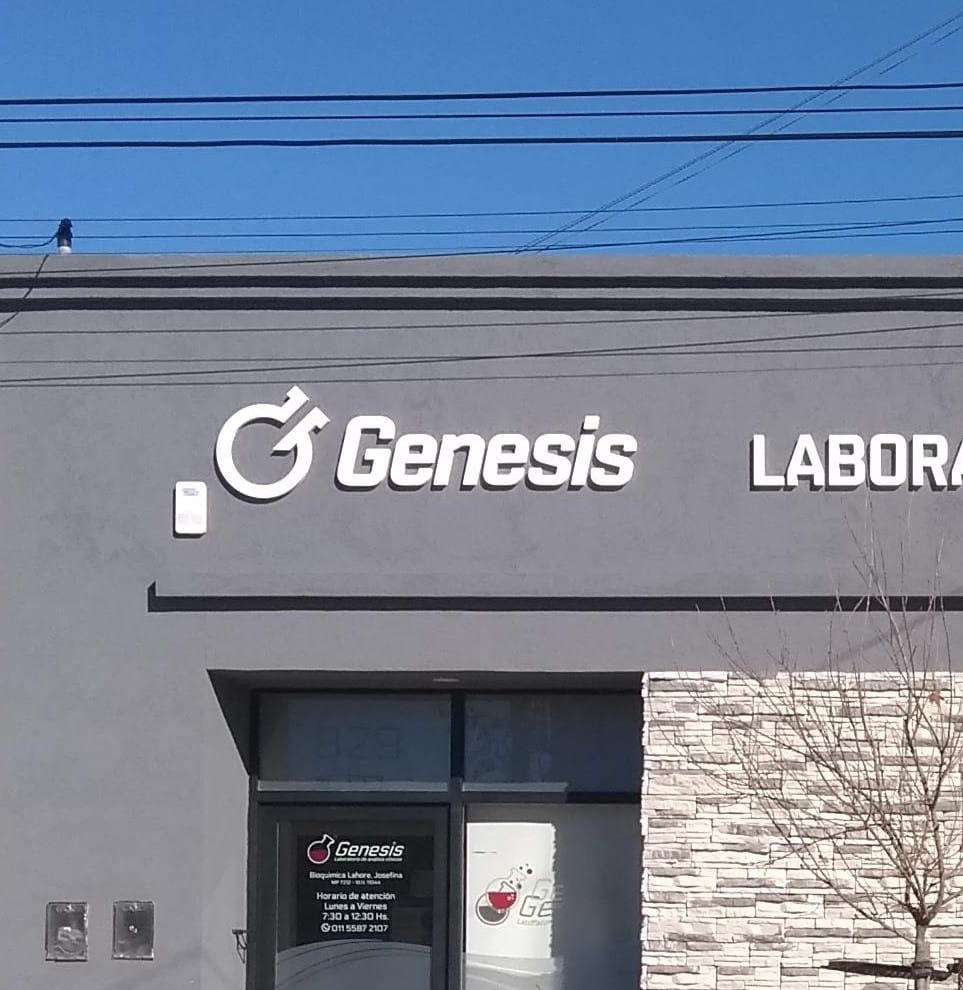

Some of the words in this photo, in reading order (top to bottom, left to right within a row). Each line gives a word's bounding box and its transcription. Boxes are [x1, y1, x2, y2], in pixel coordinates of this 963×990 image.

[335, 415, 638, 489] Genesis
[335, 841, 405, 857] Genesis
[316, 892, 347, 900] Horario
[349, 892, 359, 900] de
[361, 892, 396, 900] atención
[324, 902, 348, 911] Lunes
[356, 902, 388, 911] Viernes
[322, 912, 342, 920] 7:30
[351, 912, 374, 920] 12:30
